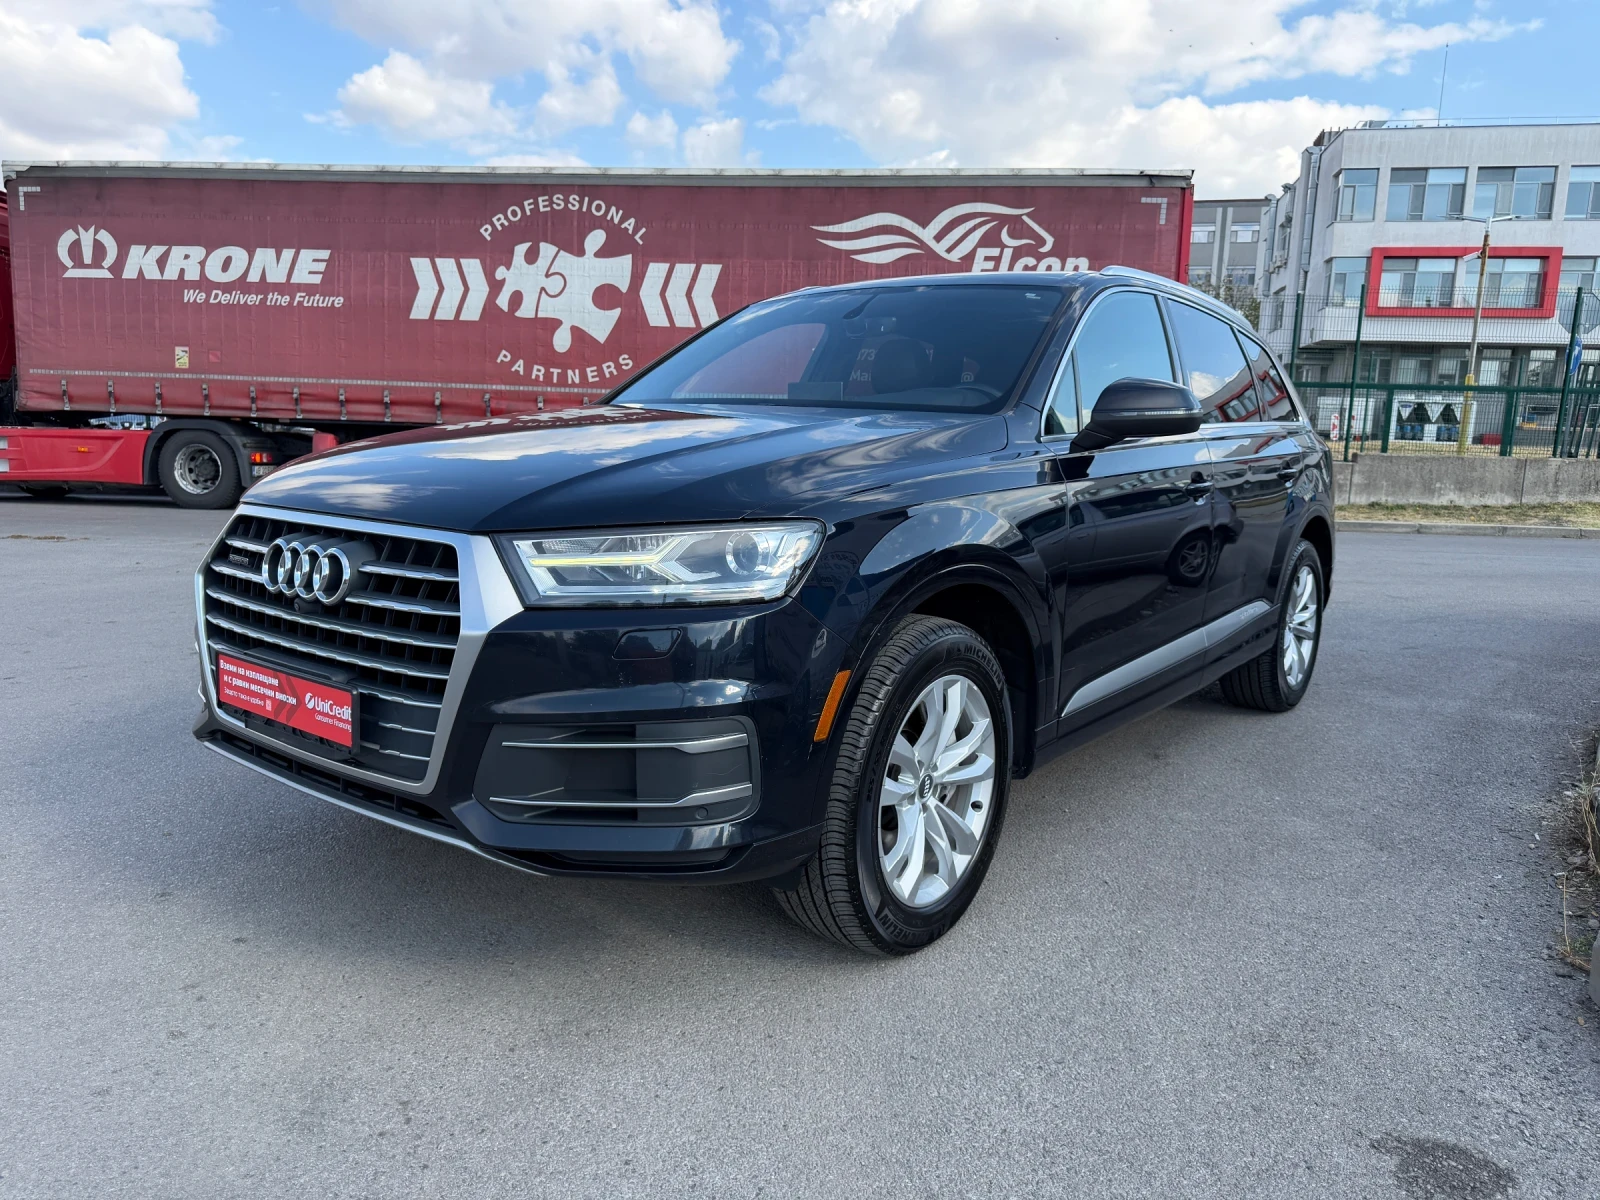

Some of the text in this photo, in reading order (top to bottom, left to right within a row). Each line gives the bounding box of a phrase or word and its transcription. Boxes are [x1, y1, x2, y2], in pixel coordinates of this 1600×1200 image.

[479, 194, 647, 245] PROFESSIONAL
[121, 244, 332, 284] KRONE
[183, 289, 344, 308] We Deliver the Future
[496, 349, 633, 385] PARTNERS
[849, 369, 872, 382] Mai
[220, 660, 237, 673] Вземи
[237, 667, 245, 676] на
[963, 643, 1004, 685] MICHELIN
[232, 677, 250, 690] равни
[250, 683, 275, 698] месечни
[275, 692, 297, 706] вноски
[315, 696, 352, 721] UniCredit
